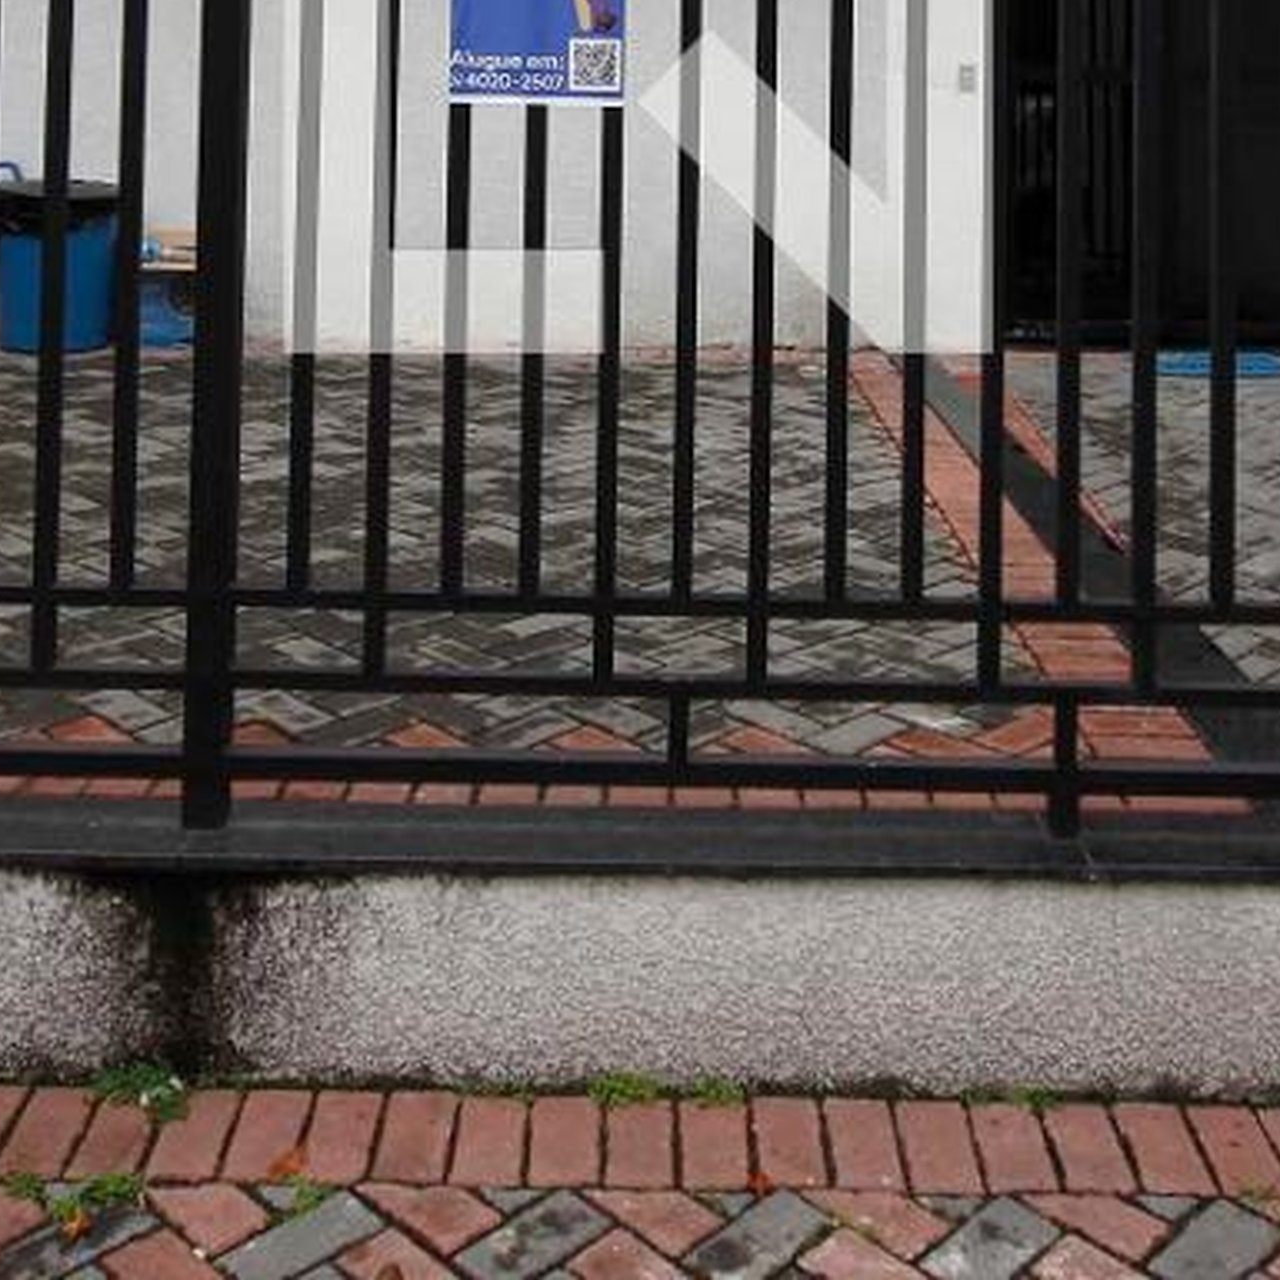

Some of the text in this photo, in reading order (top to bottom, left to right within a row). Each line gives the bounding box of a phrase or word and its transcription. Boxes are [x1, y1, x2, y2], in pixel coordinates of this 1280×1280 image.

[452, 49, 564, 72] Alugue em:
[466, 72, 564, 91] 4020-2507
